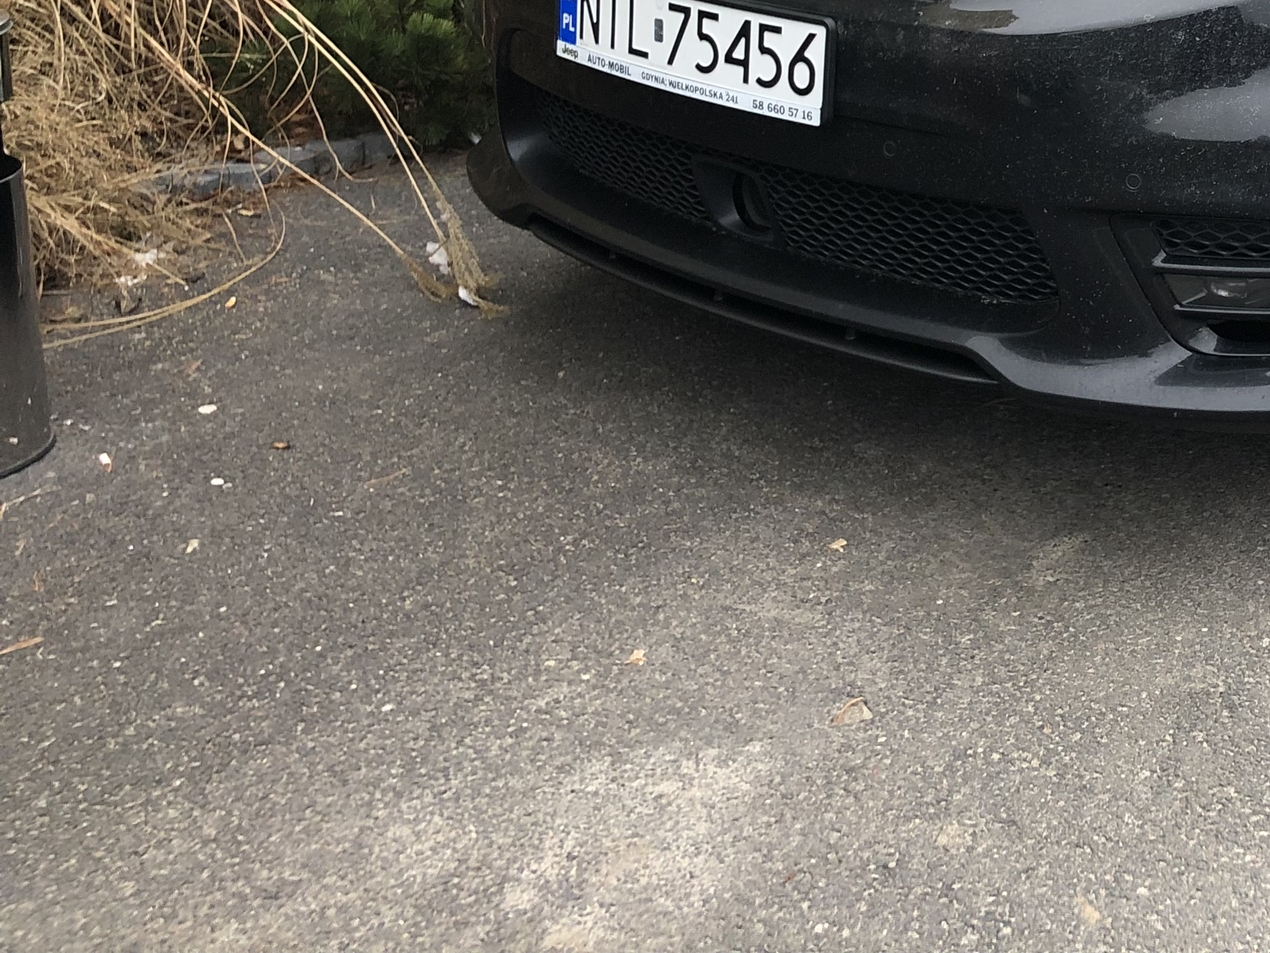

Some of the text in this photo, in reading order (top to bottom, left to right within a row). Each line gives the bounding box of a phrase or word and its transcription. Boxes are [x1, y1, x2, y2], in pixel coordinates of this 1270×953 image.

[563, 13, 575, 32] PL
[666, 2, 817, 96] 75456
[561, 44, 579, 60] Jeep
[587, 54, 632, 76] AUTO-MOBIL
[752, 99, 764, 111] 58
[767, 102, 785, 115] 660
[788, 106, 799, 118] 57
[802, 110, 813, 121] 16
